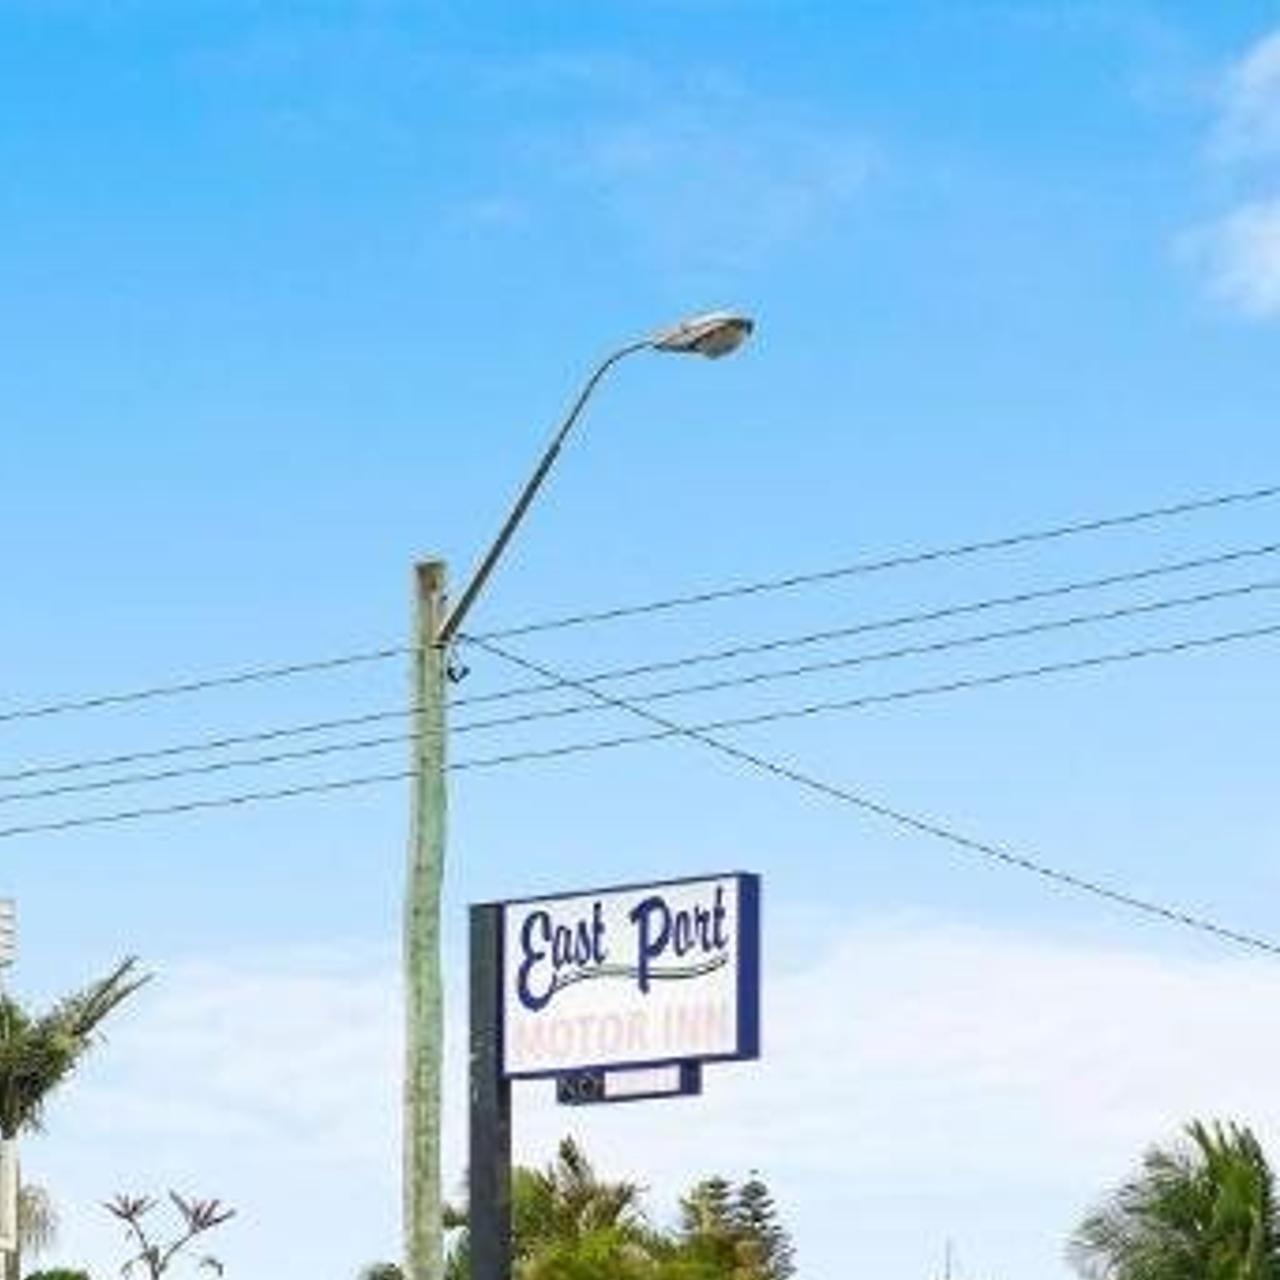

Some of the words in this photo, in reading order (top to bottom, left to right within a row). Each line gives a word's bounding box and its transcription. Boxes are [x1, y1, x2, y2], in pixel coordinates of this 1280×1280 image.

[518, 902, 606, 1011] East
[629, 886, 727, 994] Port
[515, 1007, 649, 1058] MOTOR
[663, 997, 728, 1049] INN
